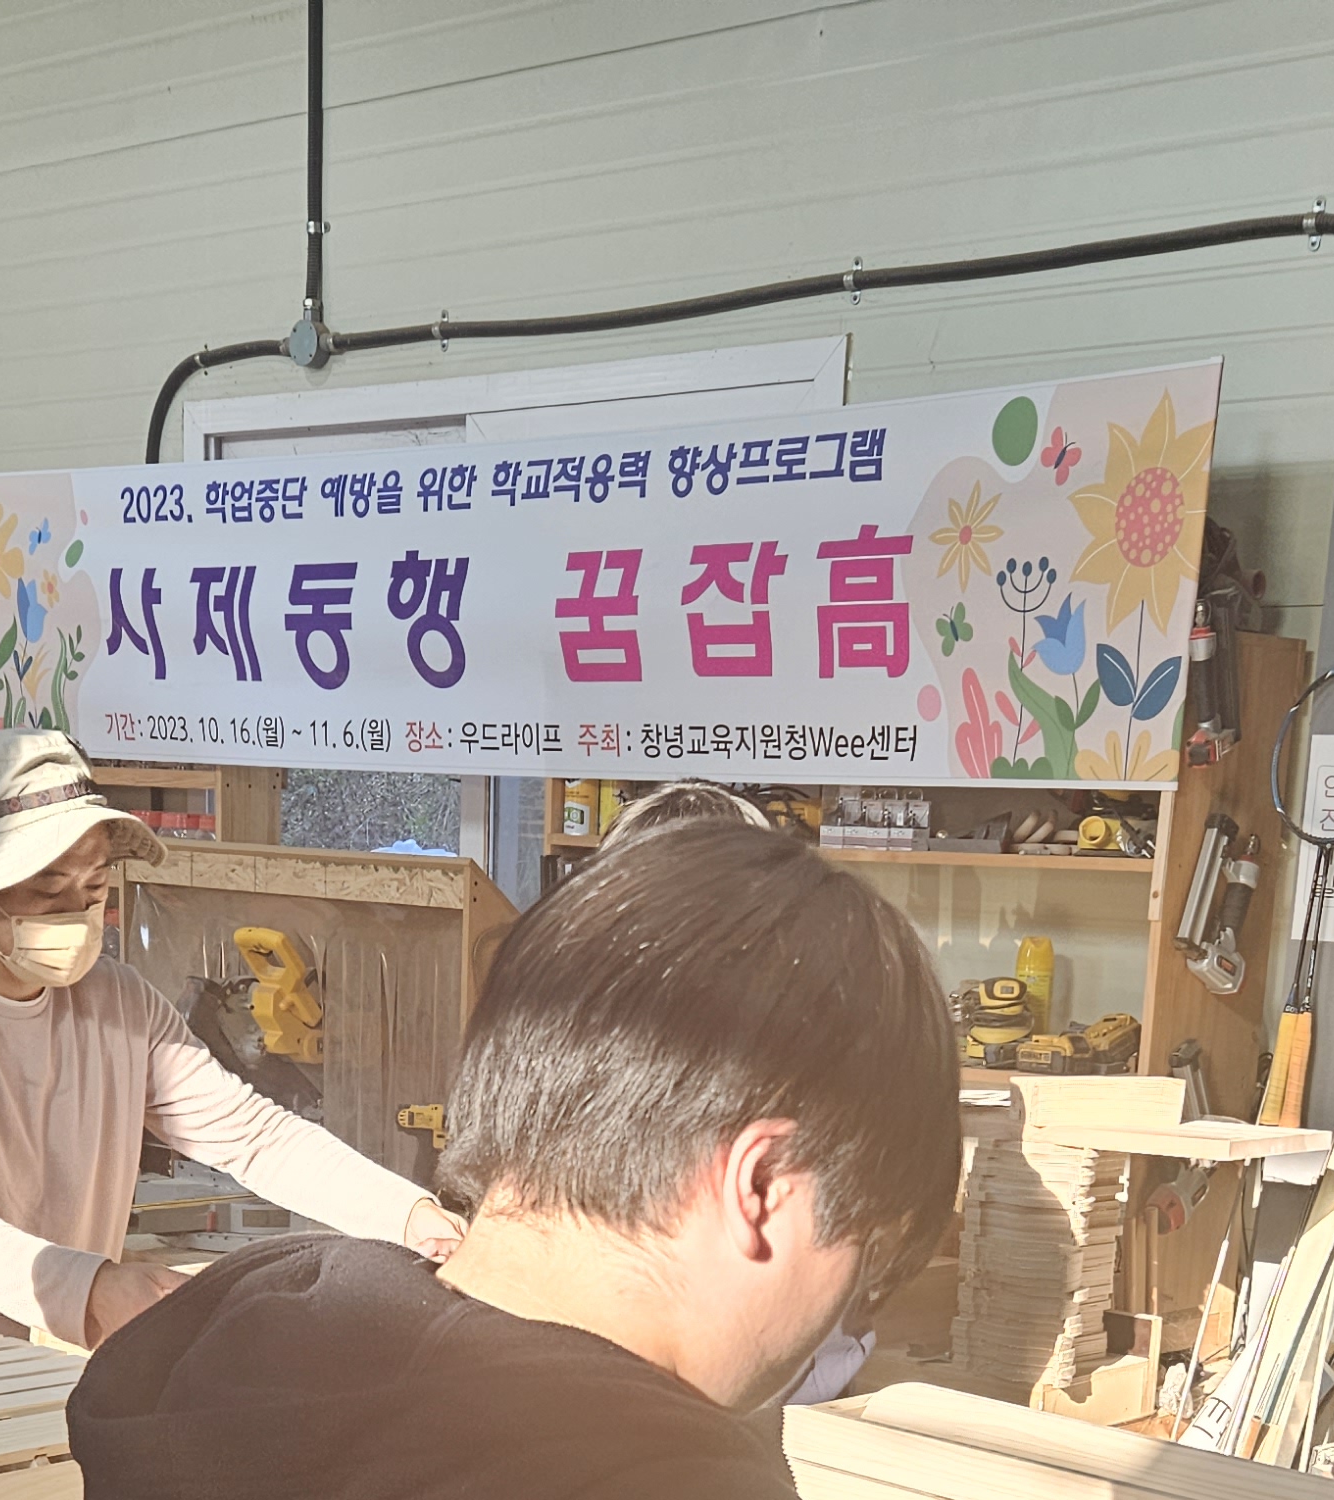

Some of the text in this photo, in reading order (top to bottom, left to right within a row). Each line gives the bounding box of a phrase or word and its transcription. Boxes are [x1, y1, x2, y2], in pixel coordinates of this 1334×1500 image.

[120, 428, 887, 524] 2023. 학업중단 예방을 위한 학교적용력 향상프로그램
[106, 524, 914, 690] 사제동행 꿈잡高
[459, 720, 563, 756] 우드라이프
[639, 722, 918, 762] 창녕교육지원청Wee센터
